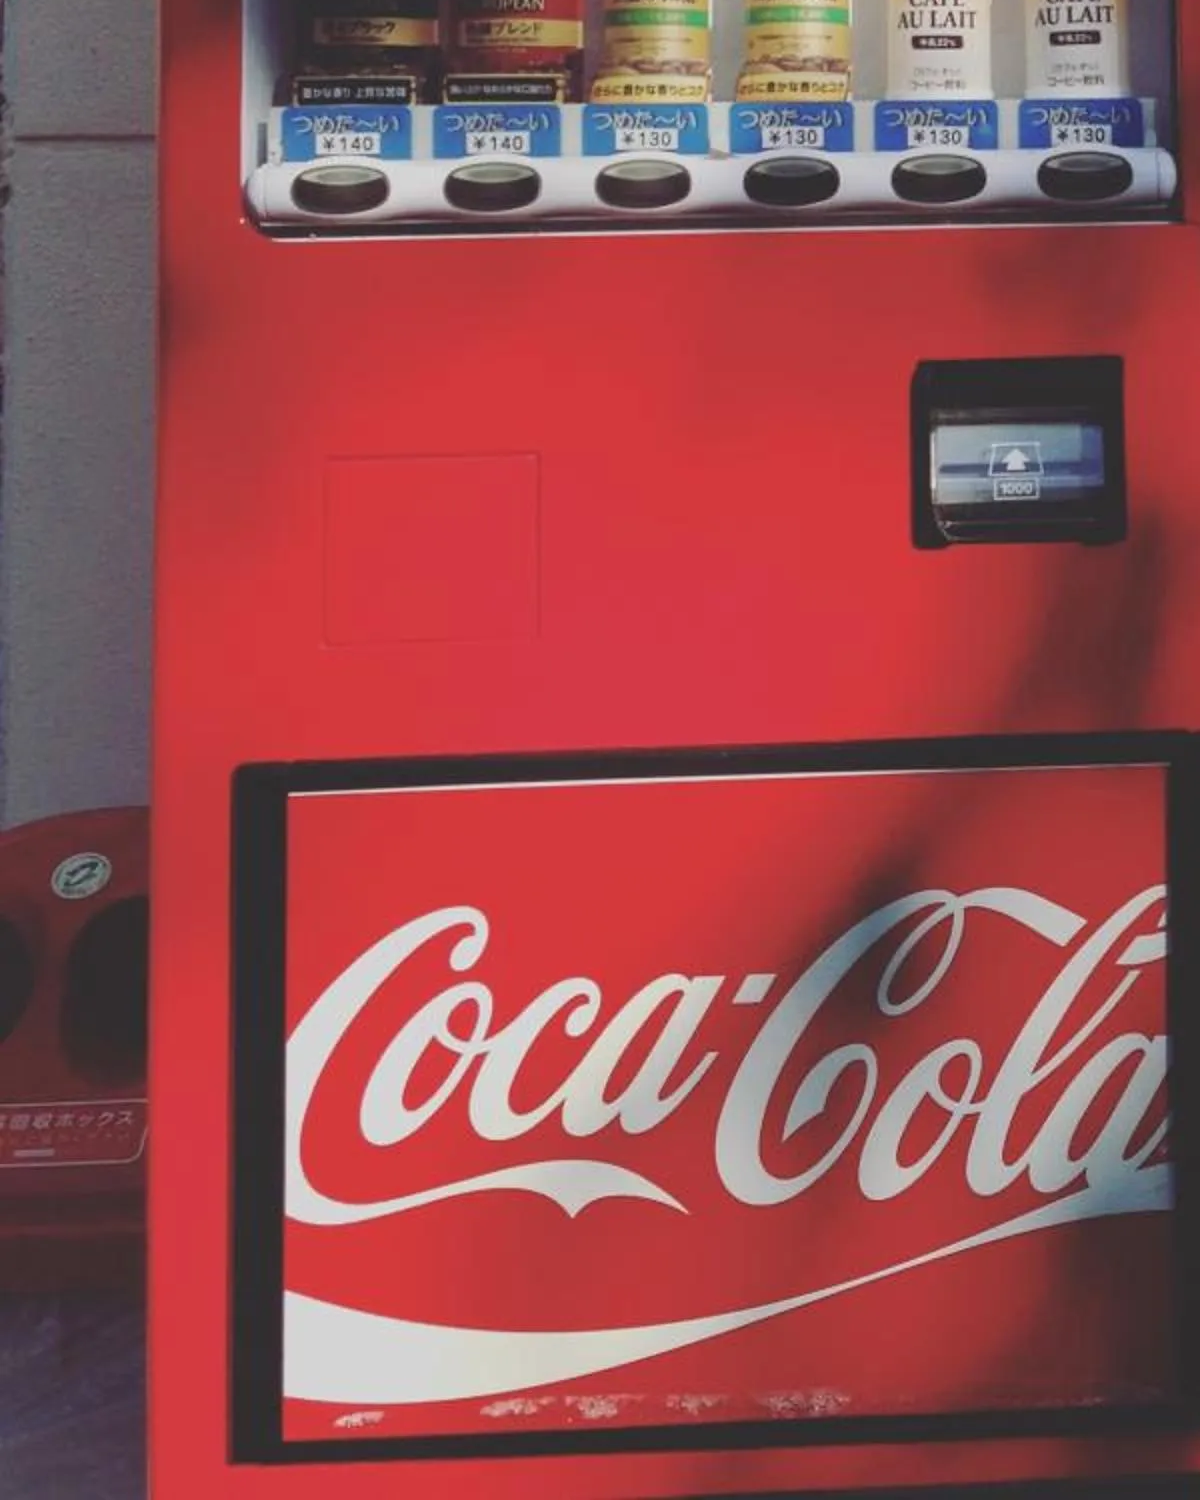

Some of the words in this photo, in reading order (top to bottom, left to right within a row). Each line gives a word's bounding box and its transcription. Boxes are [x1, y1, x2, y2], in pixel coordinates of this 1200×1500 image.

[897, 10, 923, 29] AU
[930, 10, 977, 29] LAIT
[1034, 7, 1060, 26] AU
[1066, 4, 1115, 25] LAIT
[321, 135, 374, 152] ¥140
[472, 135, 525, 151] ¥140
[621, 130, 673, 148] ¥130
[768, 128, 818, 145] ¥130
[912, 129, 963, 146] ¥130
[1056, 127, 1106, 144] ¥130
[999, 481, 1033, 495] 1000
[285, 884, 1174, 1225] Coca-Cola
[0, 1110, 133, 1131] 回収ボックス
